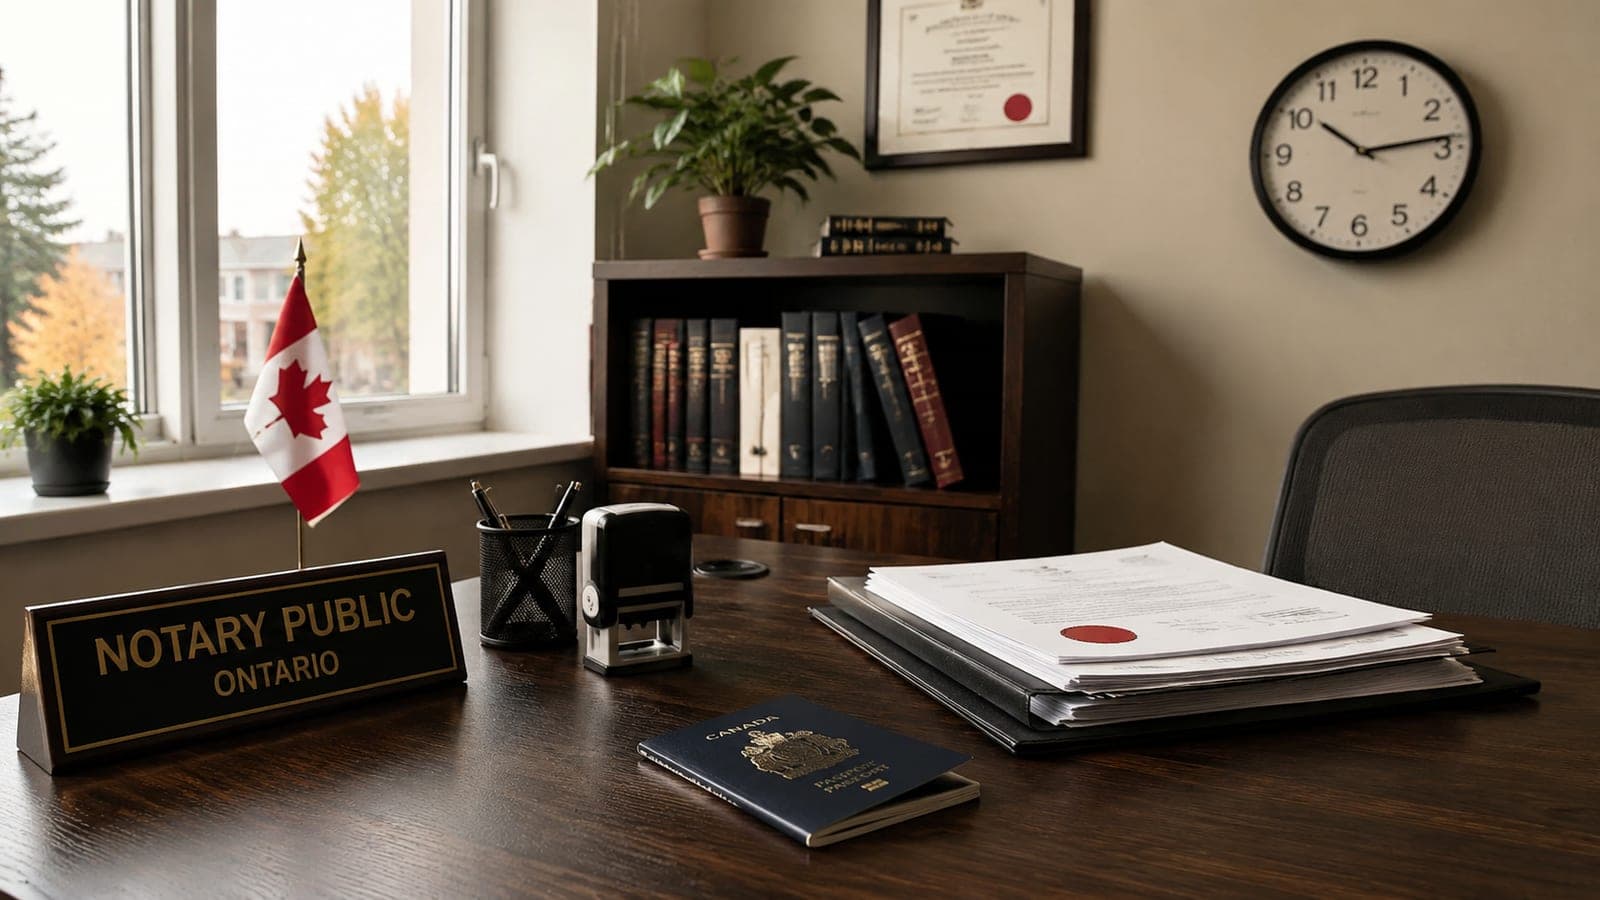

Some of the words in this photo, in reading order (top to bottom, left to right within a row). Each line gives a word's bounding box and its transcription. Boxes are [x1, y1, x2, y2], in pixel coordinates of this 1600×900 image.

[1352, 66, 1378, 89] 12
[1400, 75, 1407, 96] 1
[1317, 80, 1336, 101] 11
[1288, 107, 1313, 130] 10
[1423, 99, 1441, 121] 2
[1276, 143, 1292, 166] 9
[1434, 135, 1452, 160] 3
[1286, 180, 1303, 202] 8
[1420, 176, 1437, 197] 4
[1315, 206, 1330, 228] 7
[1351, 214, 1368, 237] 6
[1392, 204, 1408, 226] 5
[94, 610, 266, 676] NOTARY
[282, 588, 416, 643] PUBLIC
[213, 650, 340, 697] ONTARIO
[706, 715, 780, 741] CANADA
